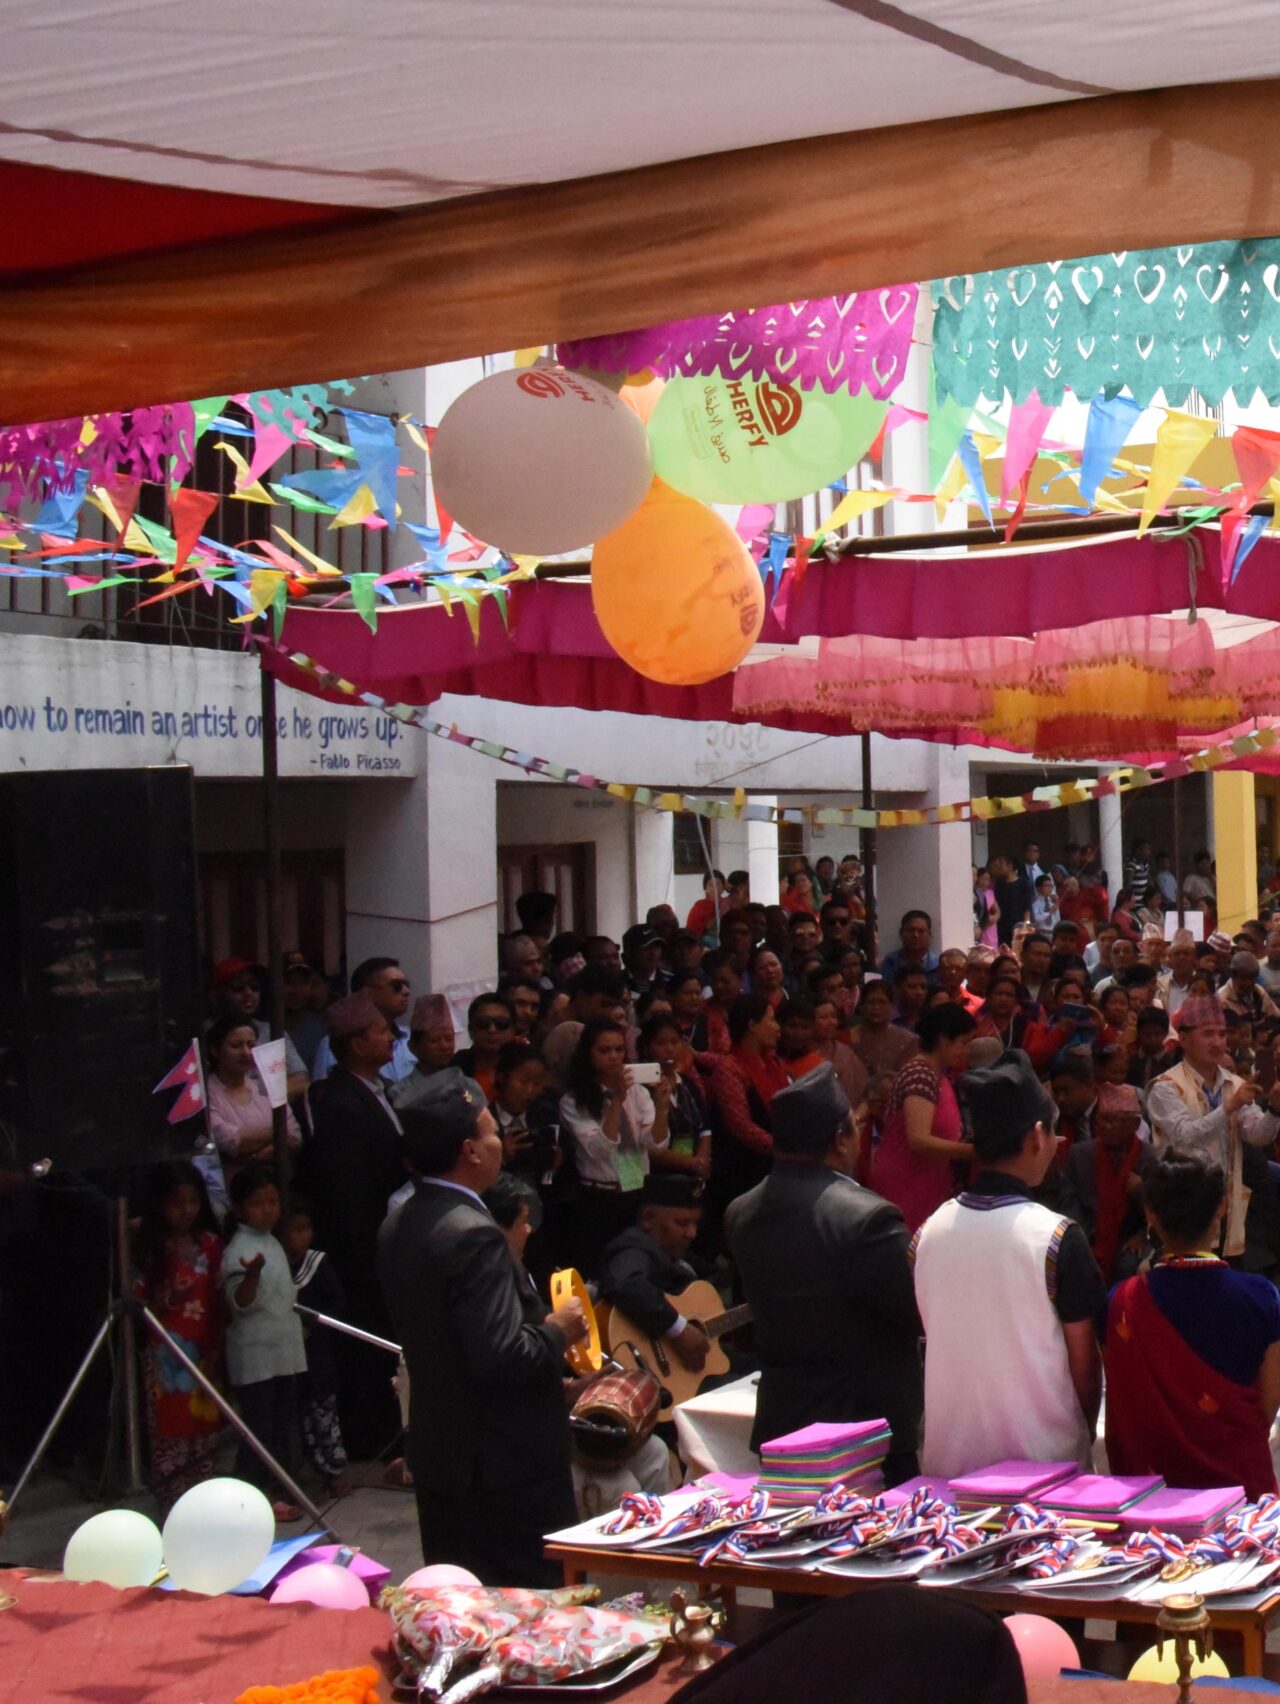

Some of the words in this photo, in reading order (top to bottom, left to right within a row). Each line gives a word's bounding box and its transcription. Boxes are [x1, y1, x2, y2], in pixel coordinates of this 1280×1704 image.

[726, 381, 769, 446] HERFY
[0, 705, 35, 731] ow
[43, 696, 68, 733] to
[75, 700, 145, 736] remain
[152, 710, 177, 737] an
[181, 705, 239, 738] artist
[245, 715, 288, 739] oe
[293, 706, 312, 739] he
[318, 715, 369, 748] grows
[375, 716, 404, 749] up.
[356, 753, 401, 770] Picasso
